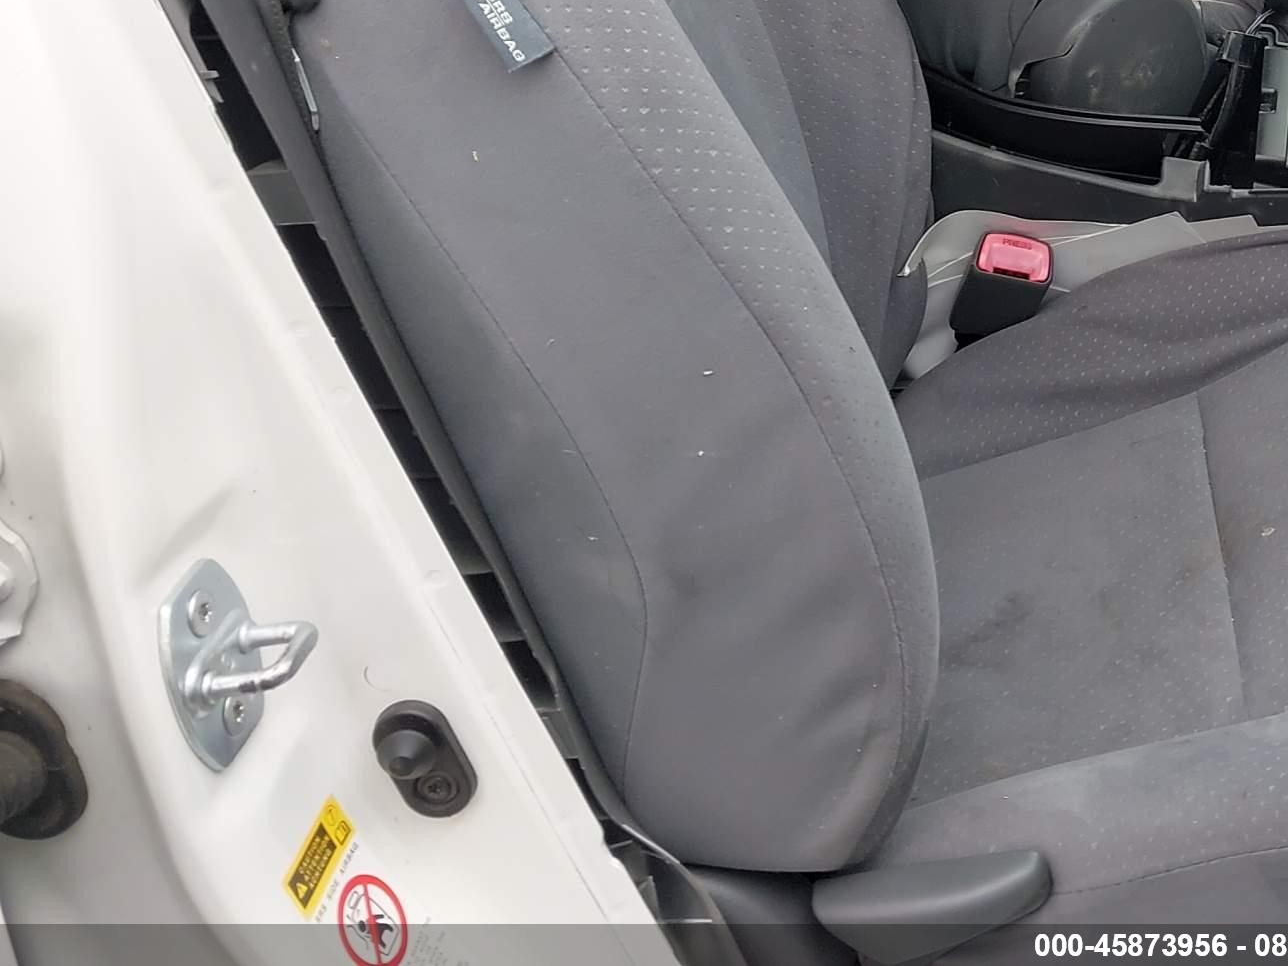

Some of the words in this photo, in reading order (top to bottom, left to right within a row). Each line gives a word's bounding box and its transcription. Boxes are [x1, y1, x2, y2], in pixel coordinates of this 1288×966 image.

[478, 1, 526, 62] AIRBAG
[1002, 238, 1033, 250] PRESS
[299, 836, 321, 875] CAUTION
[339, 841, 360, 875] AIRBAG
